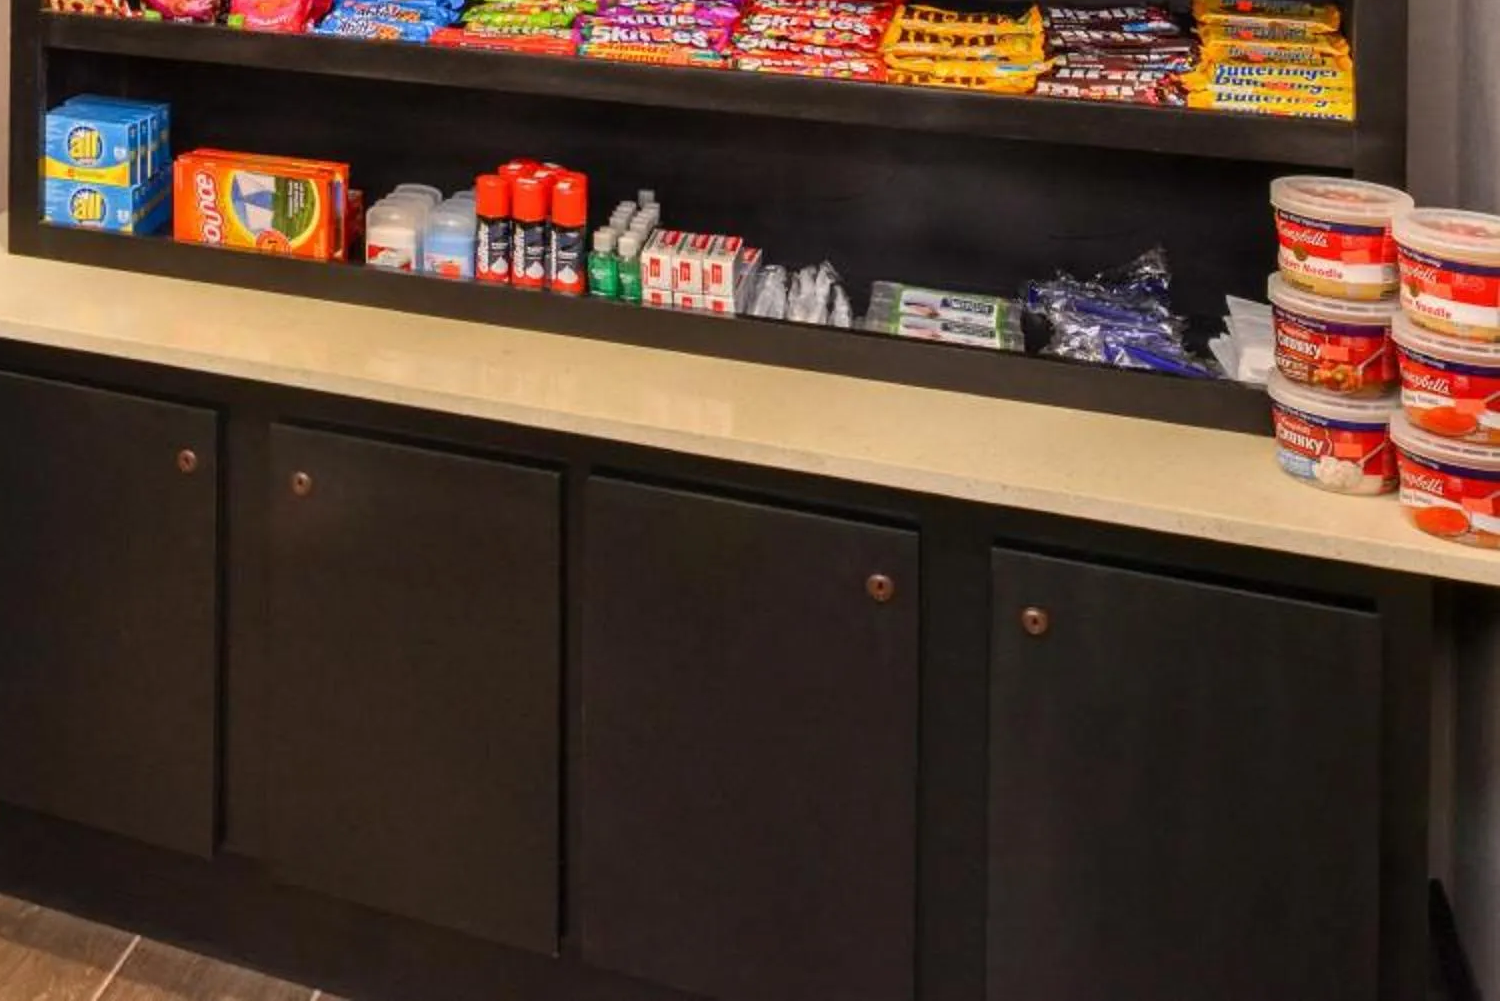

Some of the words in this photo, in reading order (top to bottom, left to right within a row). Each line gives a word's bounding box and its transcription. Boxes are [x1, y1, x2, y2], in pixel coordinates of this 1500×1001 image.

[69, 129, 100, 160] all
[73, 189, 102, 221] all
[195, 170, 224, 245] ounce
